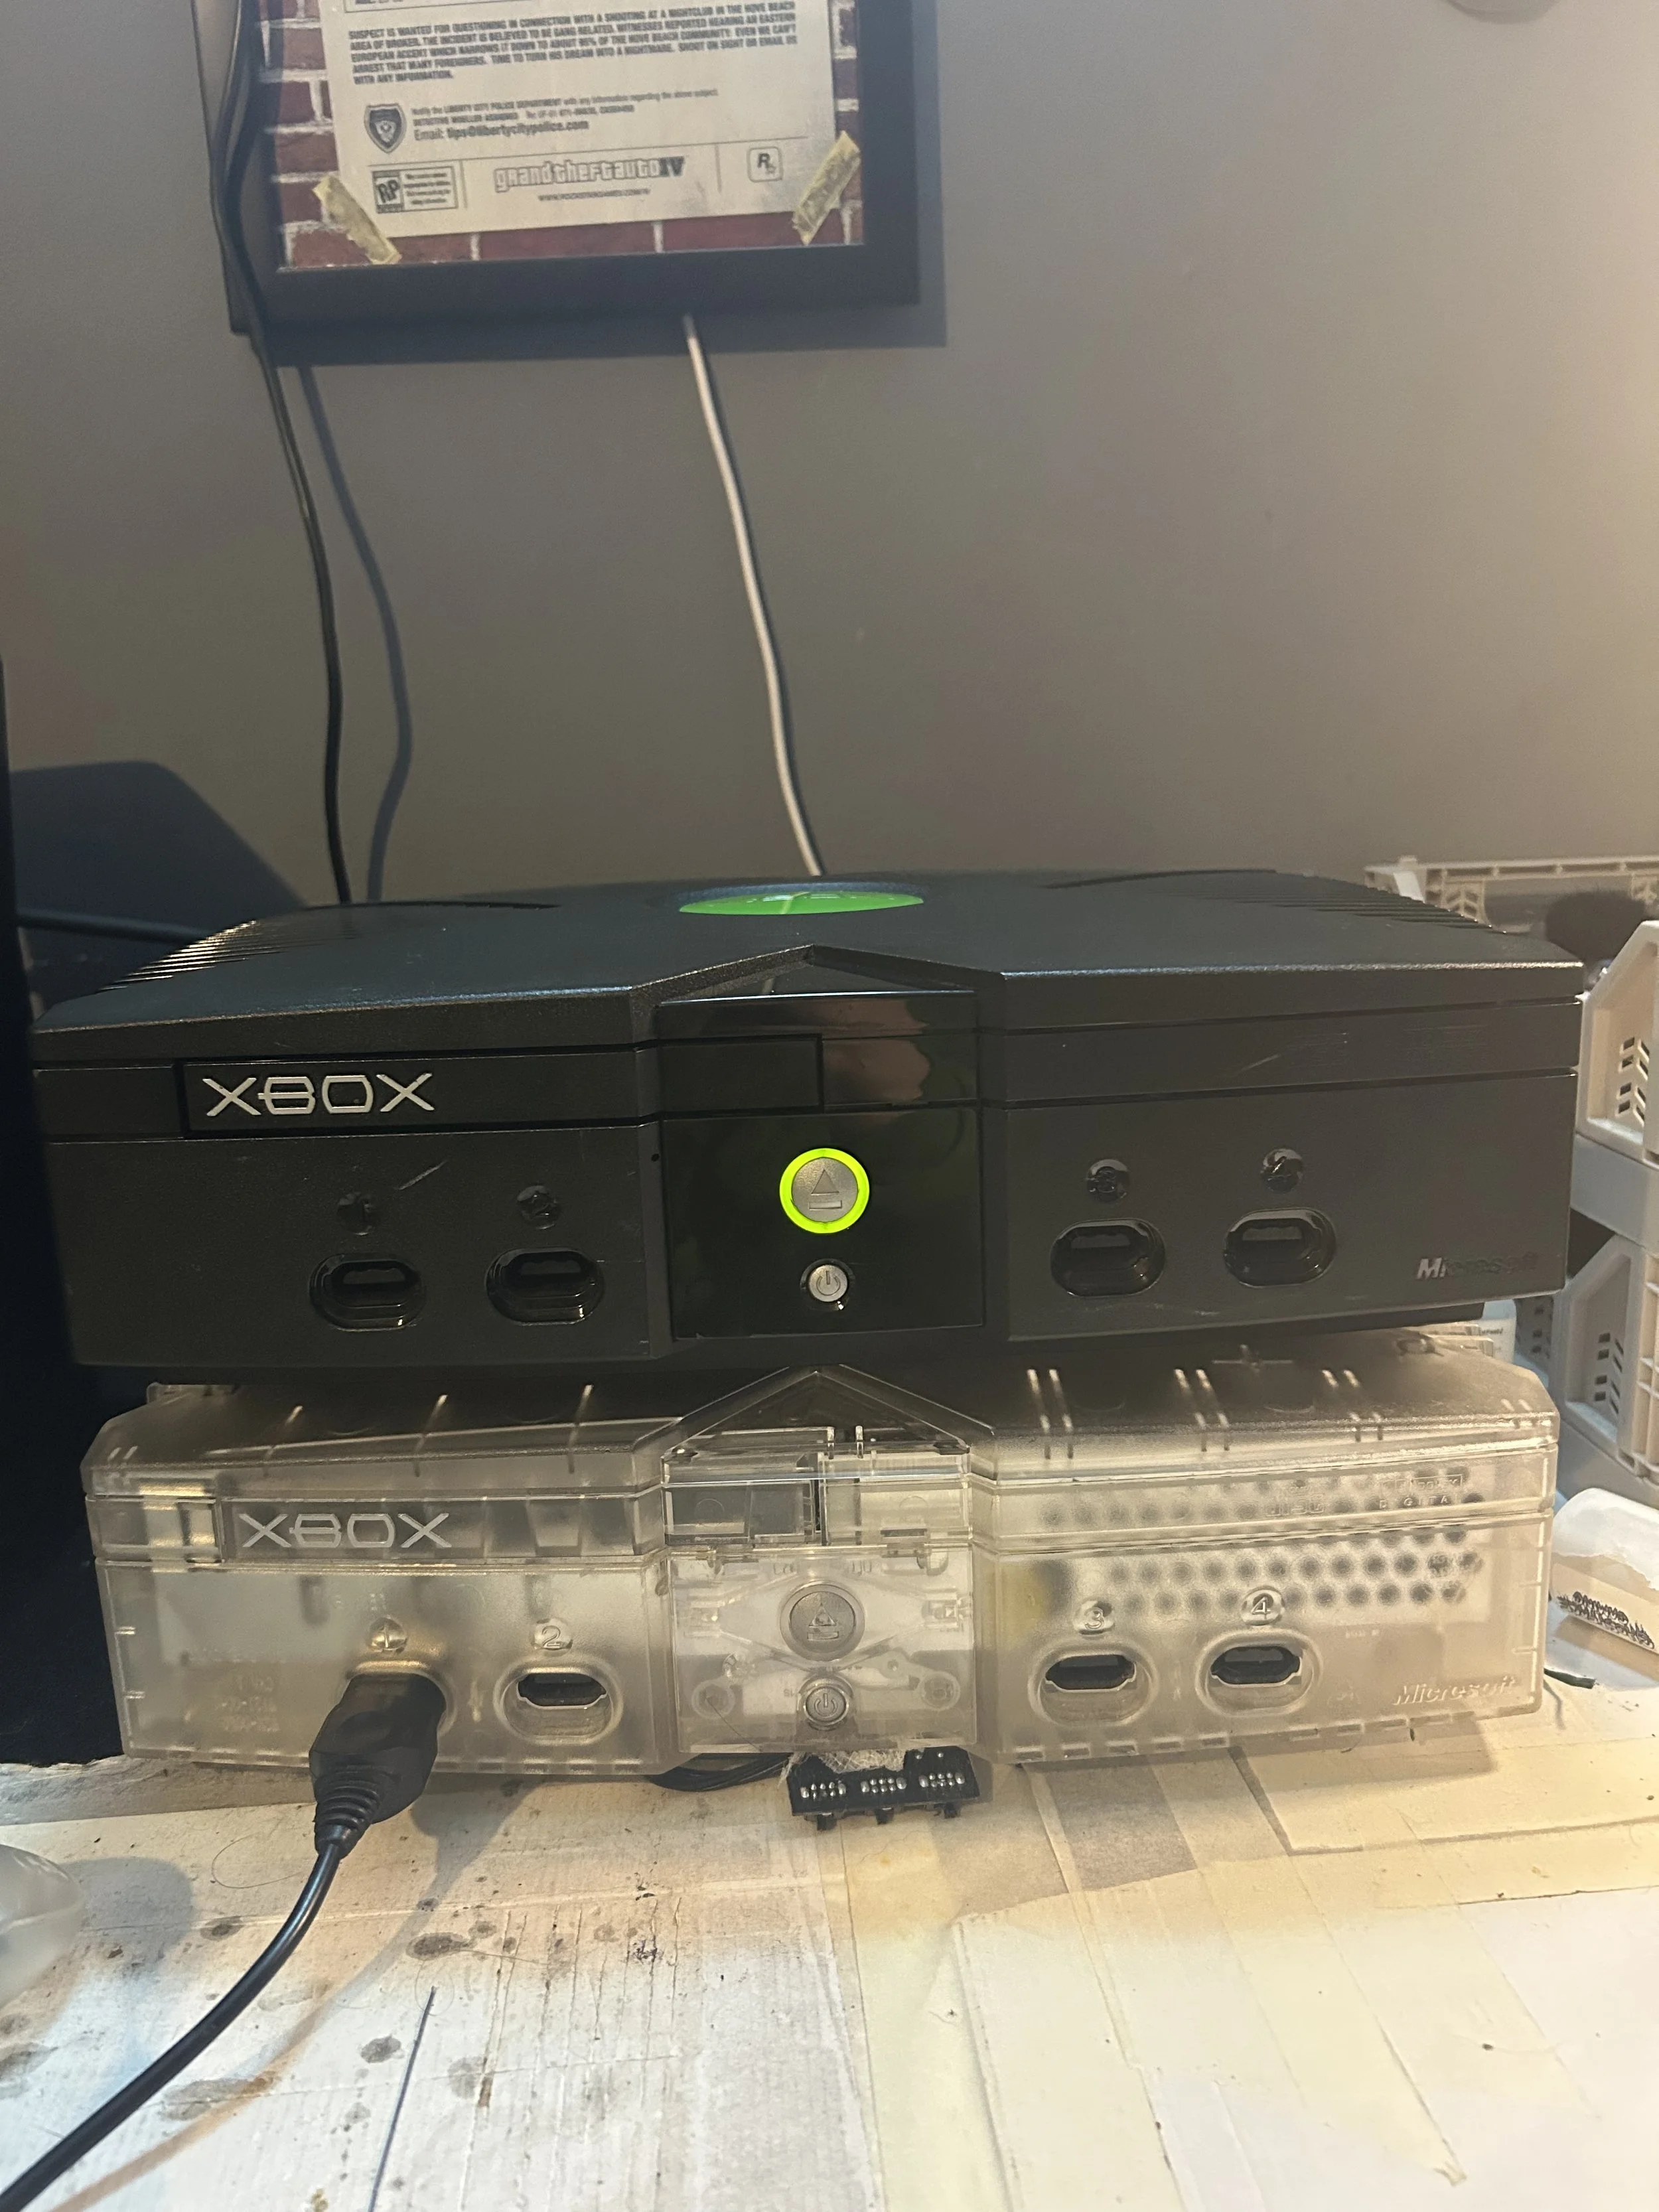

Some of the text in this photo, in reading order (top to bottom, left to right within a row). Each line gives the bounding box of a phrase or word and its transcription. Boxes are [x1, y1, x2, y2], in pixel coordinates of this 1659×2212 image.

[376, 179, 400, 203] RP
[202, 1072, 435, 1117] XBOX
[238, 1513, 452, 1548] XBOX
[1084, 1605, 1105, 1630] 3
[1252, 1595, 1271, 1620] 4
[541, 1625, 561, 1649] 2
[1392, 1674, 1517, 1706] Microsoft
